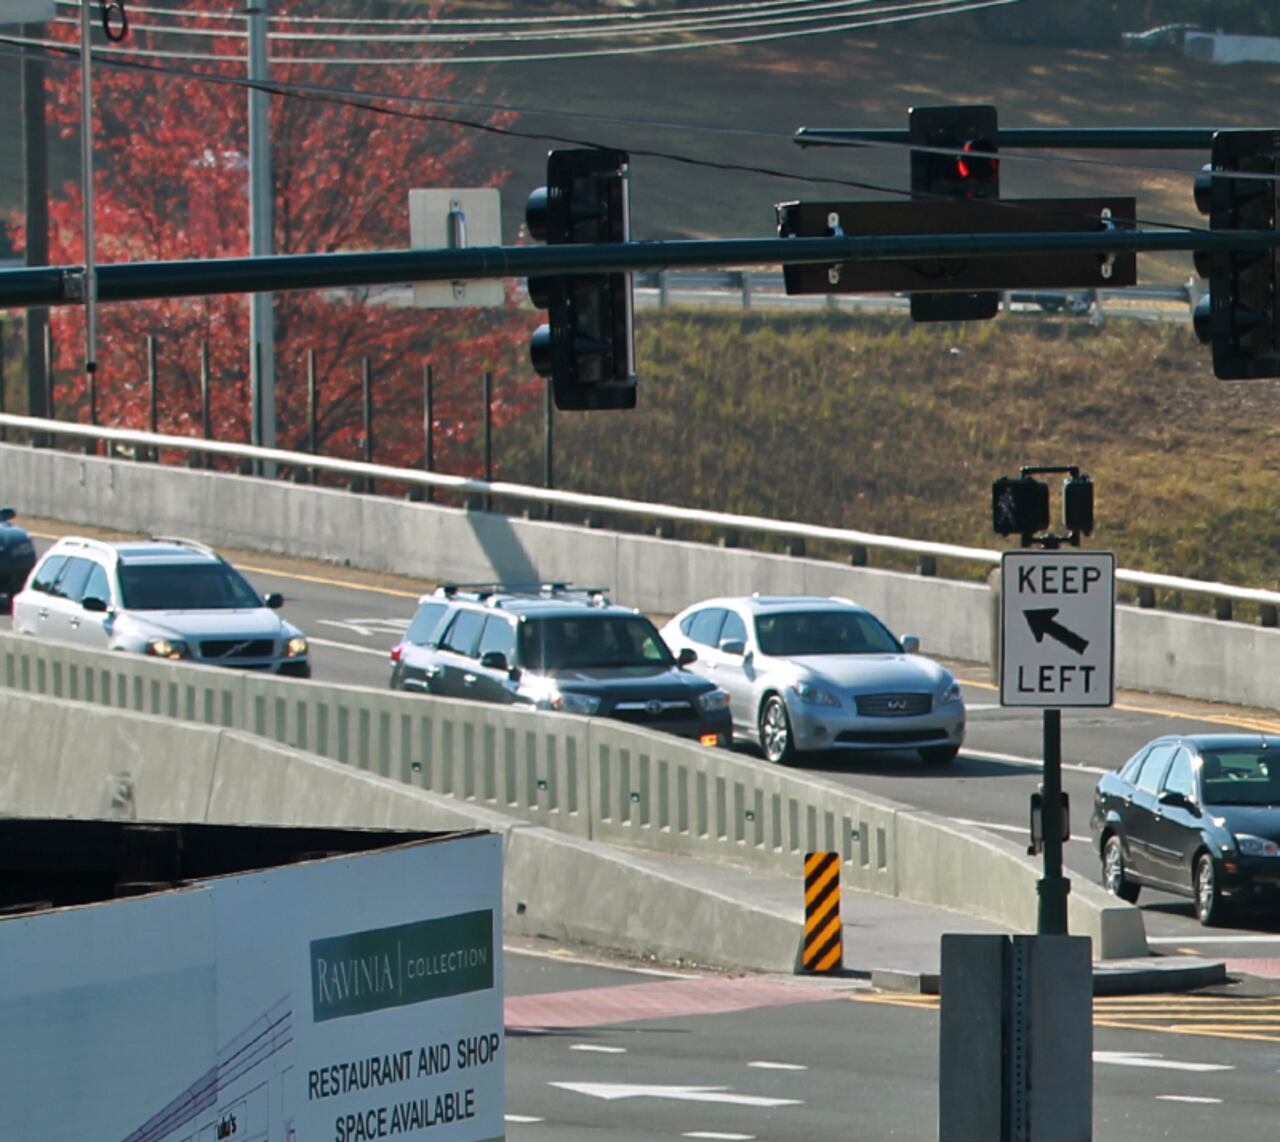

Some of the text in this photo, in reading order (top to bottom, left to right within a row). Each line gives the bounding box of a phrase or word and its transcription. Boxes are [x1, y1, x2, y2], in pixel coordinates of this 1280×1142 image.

[1018, 566, 1101, 594] KEEP
[1018, 665, 1096, 693] LEFT
[317, 947, 488, 1004] RAVINIA COLLECTION
[308, 1033, 500, 1101] RESTAURANT AND SHOP
[390, 1089, 475, 1135] AVAILABLE
